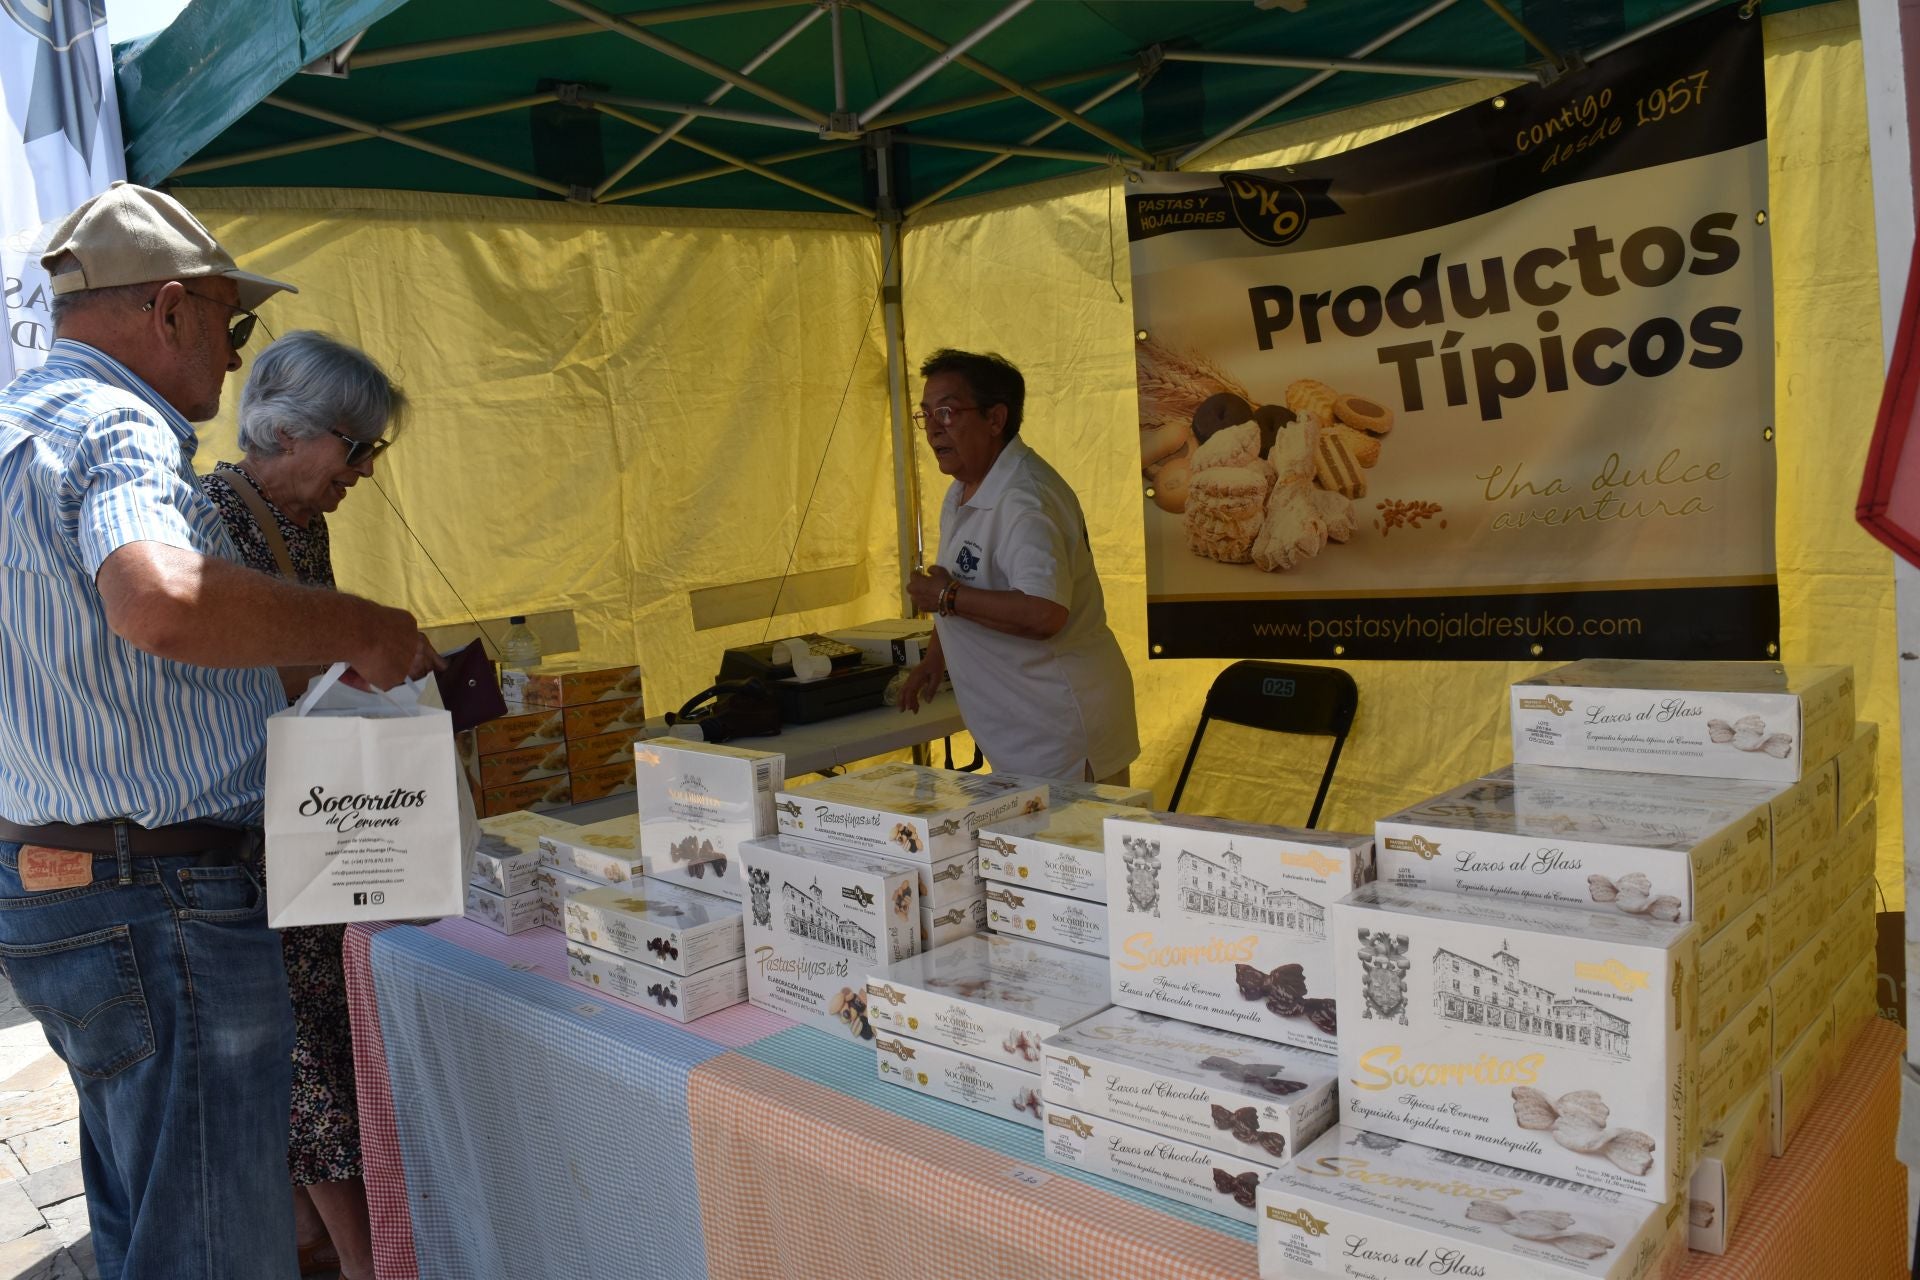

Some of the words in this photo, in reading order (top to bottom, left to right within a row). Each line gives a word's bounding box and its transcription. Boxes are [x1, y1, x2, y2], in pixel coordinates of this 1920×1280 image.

[1516, 88, 1612, 151] contigo
[1541, 116, 1623, 173] desde
[1636, 70, 1709, 126] 1957
[1138, 198, 1193, 213] PASTAS
[1198, 197, 1208, 209] Y
[1231, 180, 1299, 236] UKO
[1141, 211, 1226, 231] HOJALDRES
[1248, 212, 1741, 351] Productos
[1378, 305, 1743, 421] Típicos
[1475, 462, 1570, 501] Una
[1591, 448, 1731, 491] dulce
[1492, 491, 1713, 530] aventura
[1252, 611, 1642, 643] www.pastasyhojaldresuko.com
[1264, 680, 1294, 697] 025
[1584, 705, 1631, 725] Lazos
[1636, 703, 1655, 721] al
[1656, 697, 1704, 722] Glass
[298, 786, 427, 817] Socorritos
[326, 813, 339, 825] de
[337, 811, 402, 833] Cervera
[1413, 838, 1432, 859] UKO
[1454, 850, 1505, 873] Lazos
[1510, 852, 1531, 871] al
[1532, 848, 1583, 874] Glass
[855, 888, 867, 906] UKO
[1455, 879, 1489, 893] Exquisitos
[754, 944, 796, 977] Pastas
[836, 958, 849, 978] té
[1116, 932, 1260, 971] Socorritos
[767, 975, 798, 991] ELABORACIÓN
[786, 990, 817, 1005] MANTEQUILLA
[1153, 975, 1181, 991] Típicos
[1189, 982, 1222, 998] Cervera
[1574, 986, 1603, 998] Fabricado
[1118, 980, 1143, 997] Lazos
[1144, 987, 1155, 999] al
[1153, 989, 1193, 1008] Chocolate
[1211, 1006, 1262, 1023] mantequilla
[944, 1068, 993, 1089] SOCORRITOS
[1350, 1044, 1546, 1091] Socorritos
[1106, 1074, 1139, 1094] Lazos
[1141, 1082, 1154, 1095] al
[1153, 1080, 1210, 1103] Chocolate
[1397, 1093, 1436, 1112] Típicos
[1437, 1102, 1449, 1114] de
[1448, 1102, 1490, 1123] Cervera
[1072, 1116, 1086, 1138] UKO
[1350, 1097, 1401, 1121] Exquisitos
[1403, 1110, 1451, 1134] hojaldres
[1452, 1125, 1472, 1139] con
[1475, 1132, 1544, 1156] mantequilla
[1108, 1135, 1141, 1155] Lazos
[1144, 1144, 1157, 1158] al
[1155, 1143, 1212, 1166] Chocolate
[1296, 1156, 1524, 1201] Socorritos
[1280, 1174, 1332, 1195] Exquisitos
[1409, 1211, 1484, 1235] mantequilla
[1298, 1211, 1319, 1236] UKO
[1342, 1234, 1398, 1264] Lazos
[1404, 1248, 1428, 1267] al
[1429, 1247, 1487, 1278] Glass
